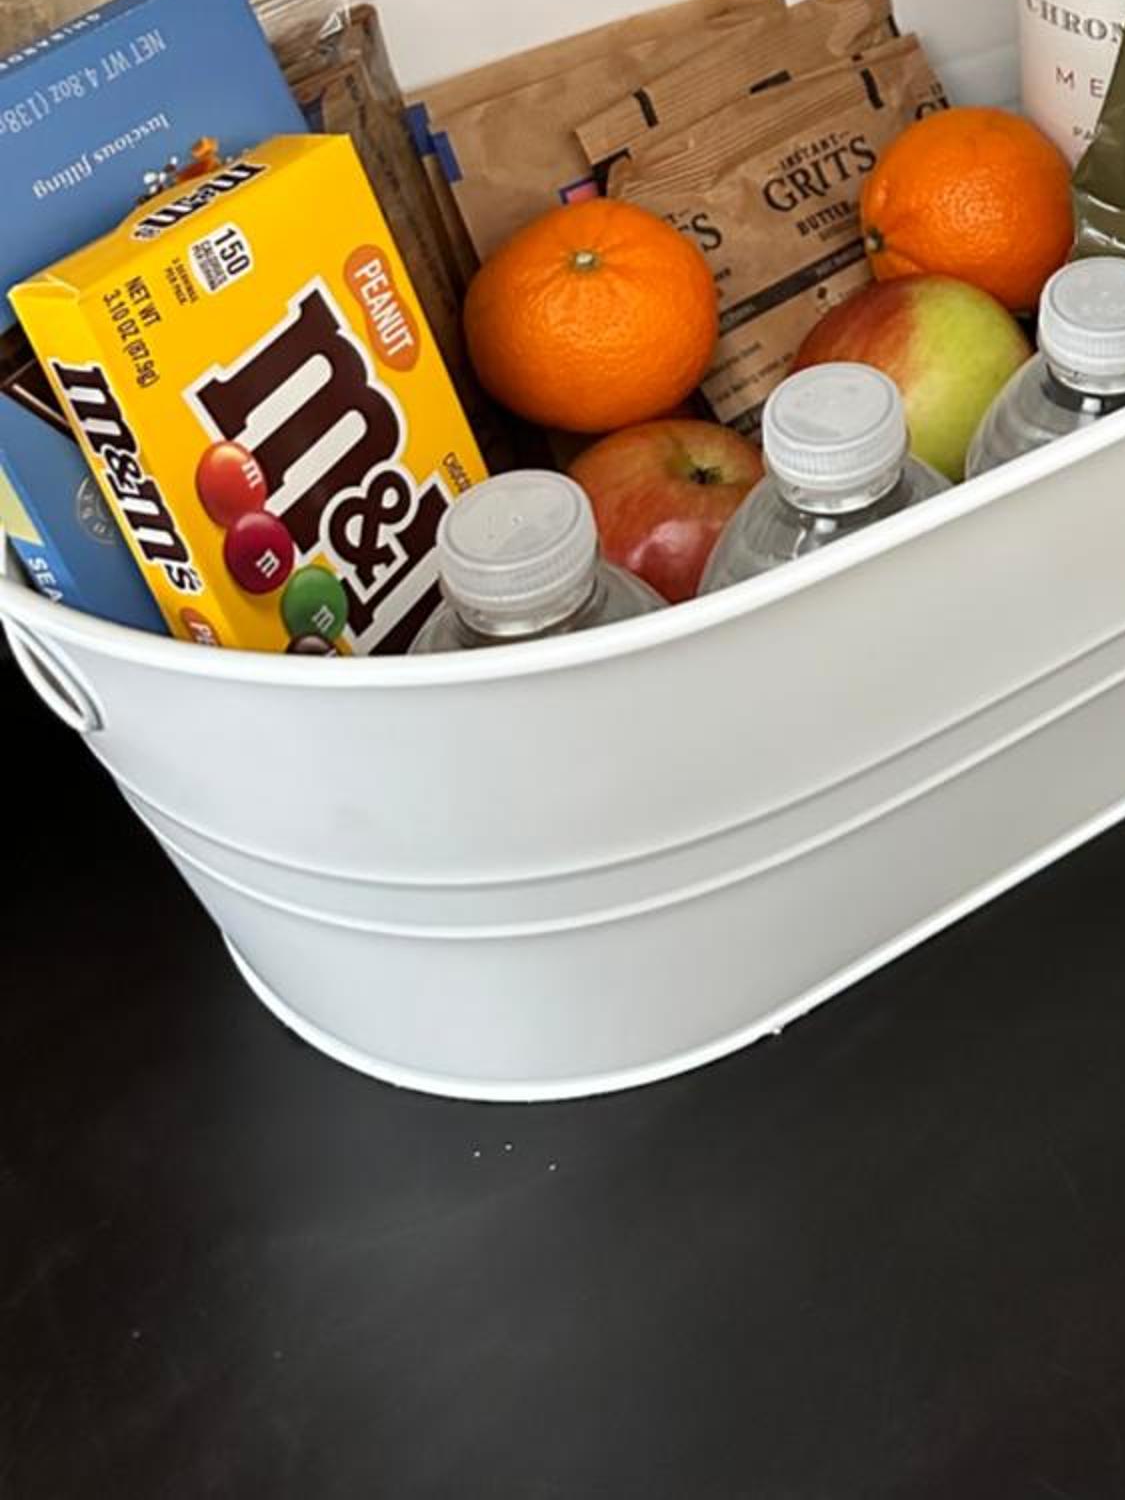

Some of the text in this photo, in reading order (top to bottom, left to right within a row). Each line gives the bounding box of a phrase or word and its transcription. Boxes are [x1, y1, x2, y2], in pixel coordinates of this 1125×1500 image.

[101, 51, 131, 81] WT
[130, 29, 166, 66] NET
[32, 113, 170, 199] luscious filling
[762, 135, 877, 212] GRITS
[780, 133, 840, 171] INSTANT
[214, 227, 251, 276] 150
[103, 289, 130, 323] 3.10
[117, 318, 140, 343] OZ
[126, 276, 162, 328] NET WT
[354, 258, 414, 357] PEANUT
